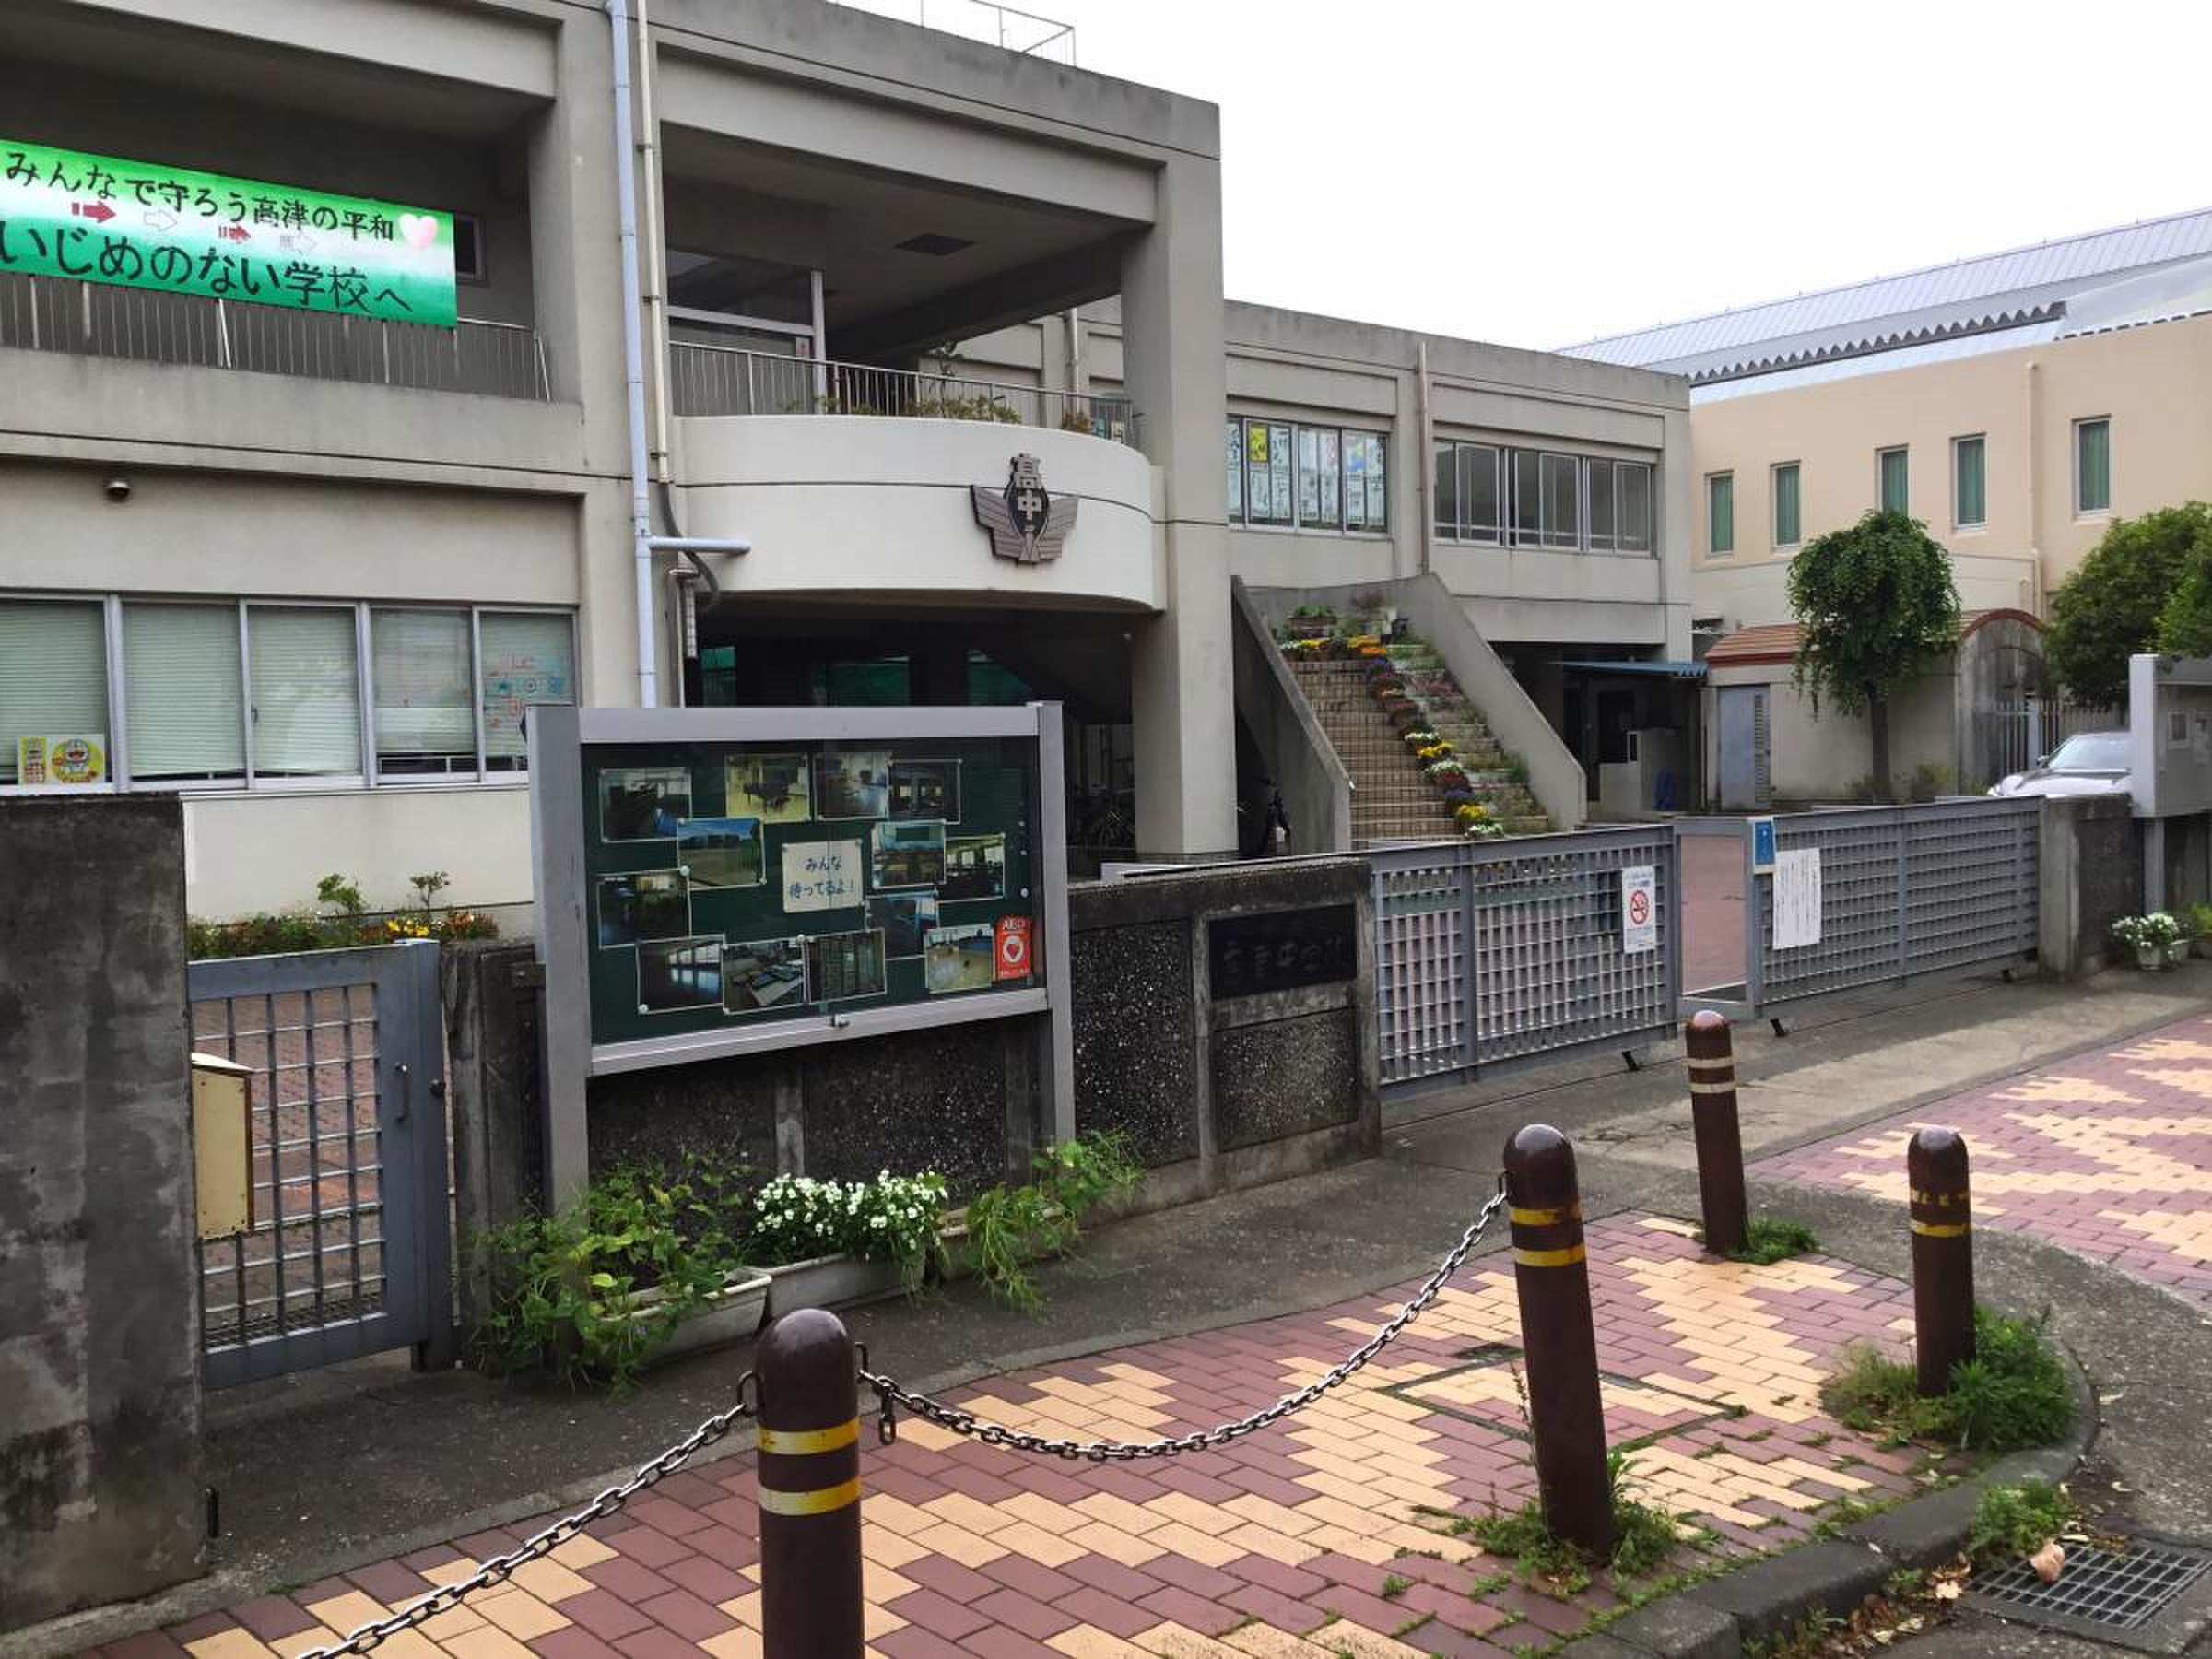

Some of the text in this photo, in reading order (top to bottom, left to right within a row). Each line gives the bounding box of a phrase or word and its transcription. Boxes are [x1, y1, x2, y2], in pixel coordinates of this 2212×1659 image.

[6, 152, 394, 241] みんなで守ろう高津の平和
[0, 220, 414, 312] いじめのない学校へ
[805, 855, 841, 872] みんな
[1002, 917, 1027, 930] AED
